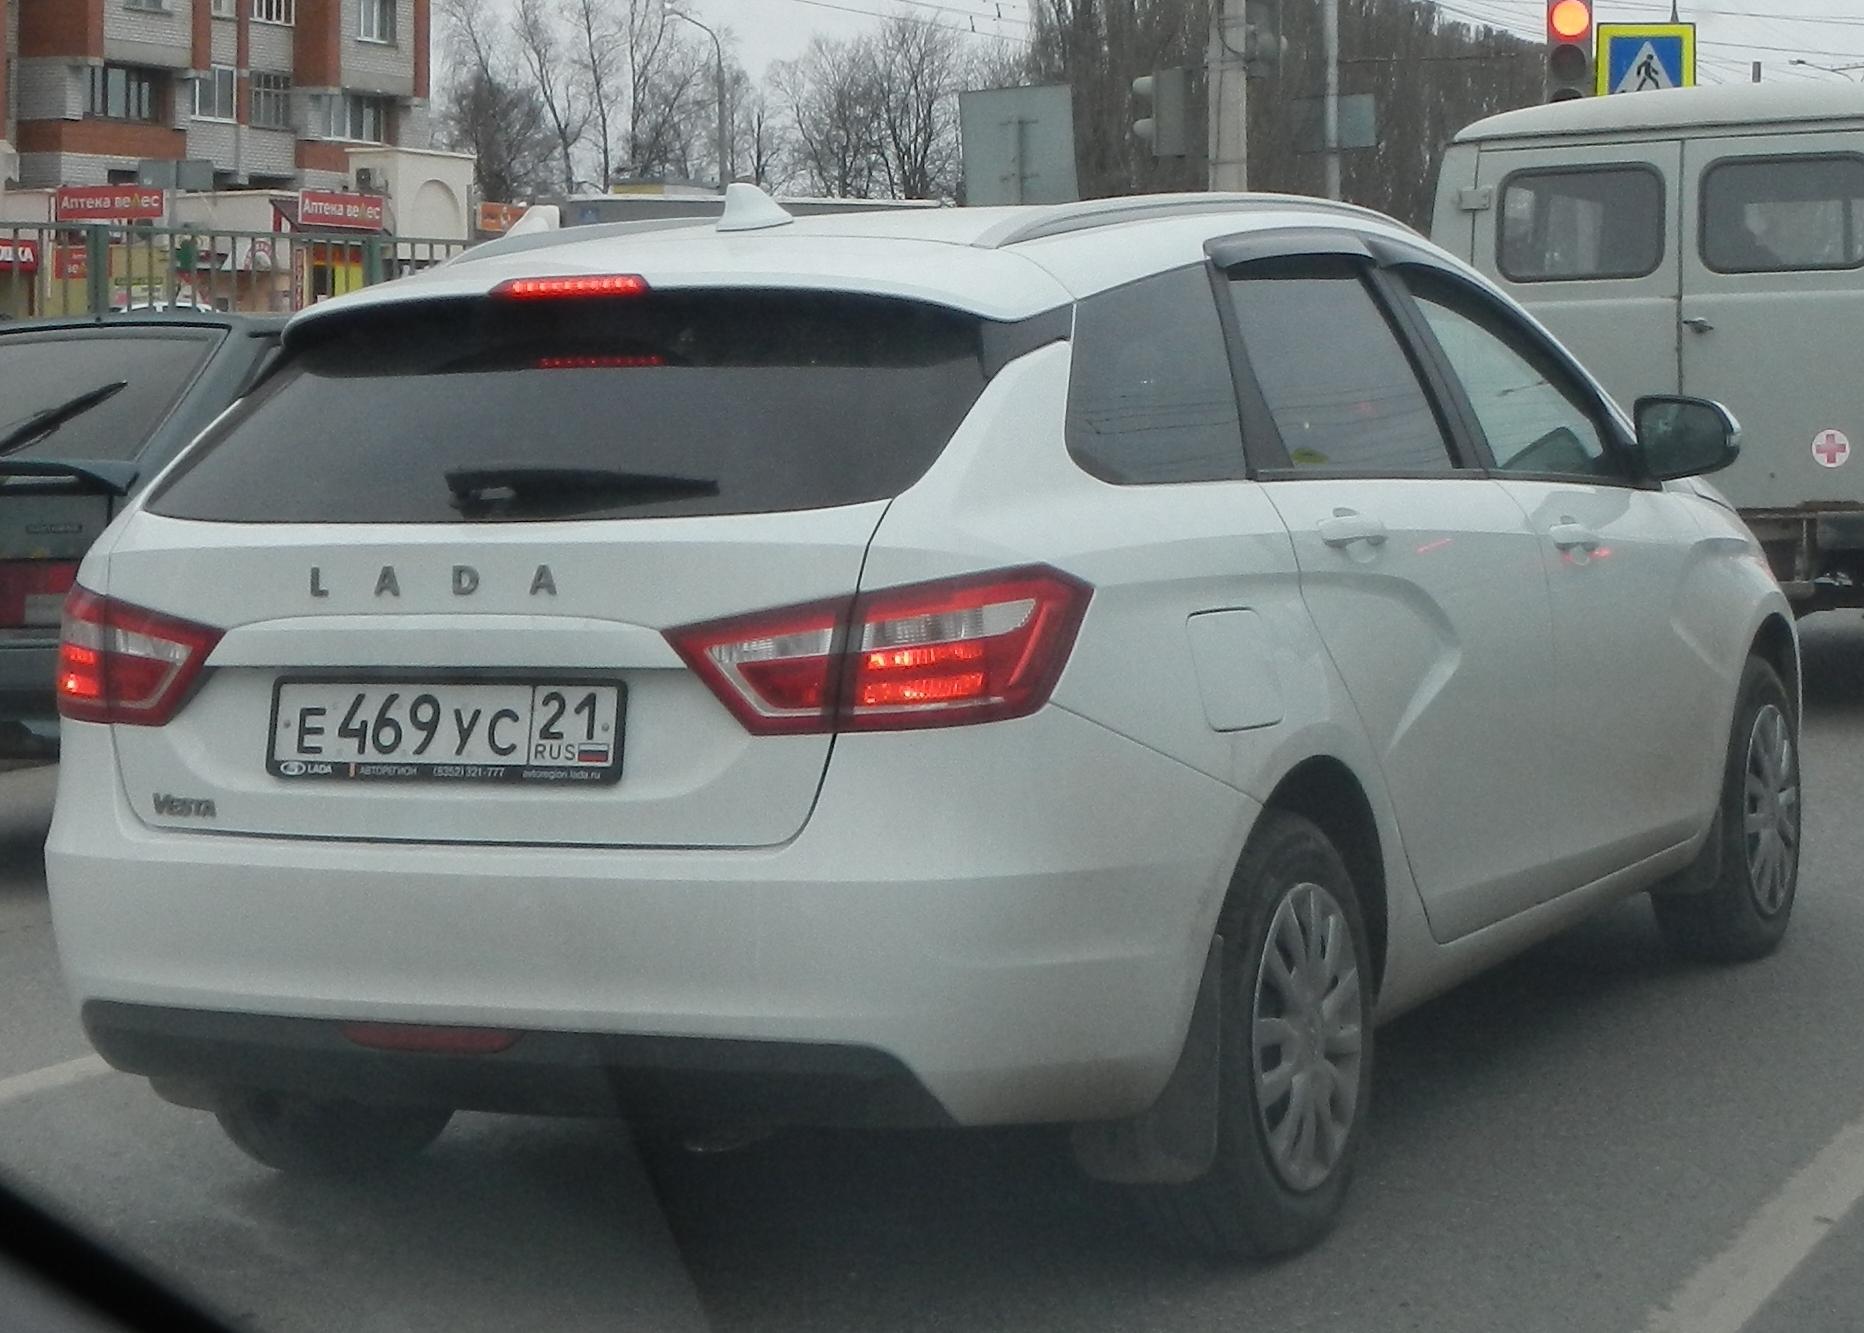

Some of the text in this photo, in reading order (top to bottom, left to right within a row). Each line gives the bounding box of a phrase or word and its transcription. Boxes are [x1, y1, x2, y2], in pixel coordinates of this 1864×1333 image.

[60, 195, 112, 209] Аптека
[303, 199, 344, 216] Аптека
[310, 565, 557, 597] LADA
[538, 691, 598, 741] 21
[533, 744, 577, 761] RUS
[308, 765, 333, 774] LADA
